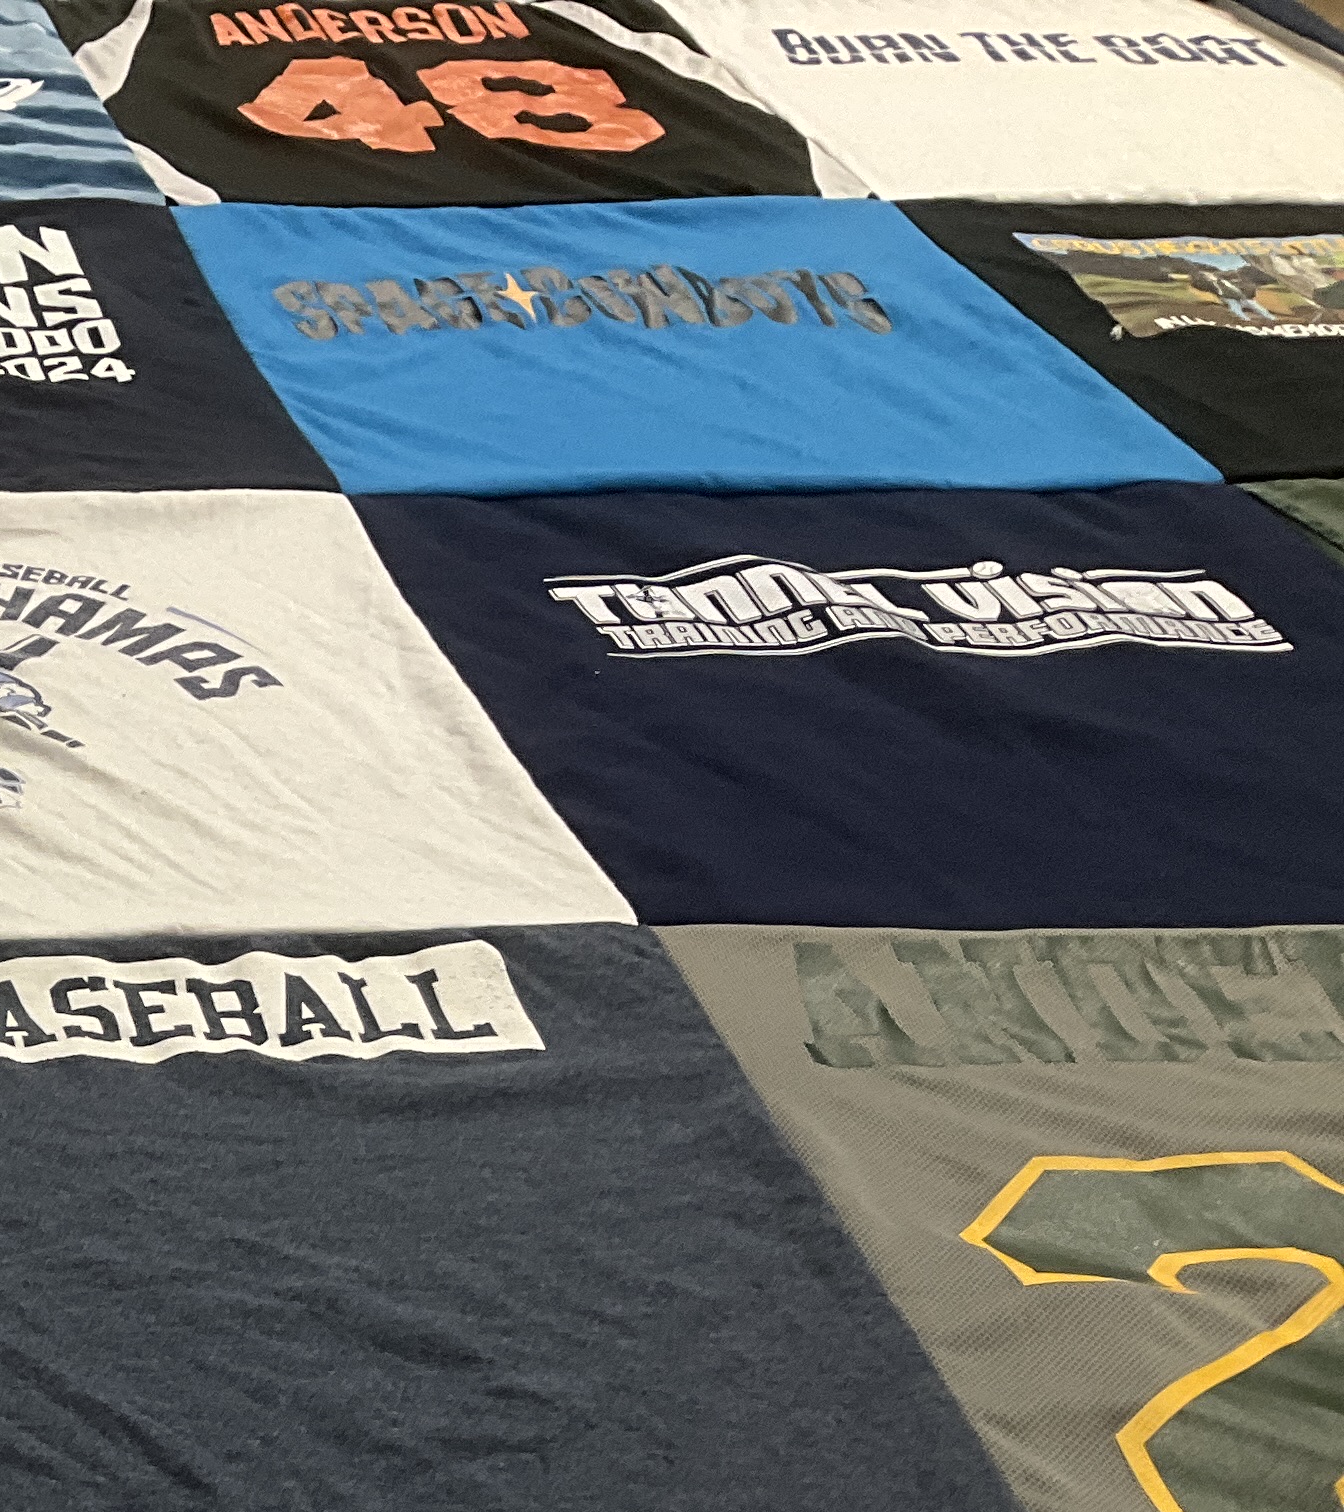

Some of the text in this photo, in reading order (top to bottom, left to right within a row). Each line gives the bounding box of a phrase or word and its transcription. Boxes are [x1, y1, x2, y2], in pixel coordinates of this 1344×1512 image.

[208, 2, 531, 46] ANDERSON
[771, 28, 962, 66] BURN
[960, 31, 1099, 65] THE
[596, 605, 1284, 650] TRAINING AND PERFORMANCE
